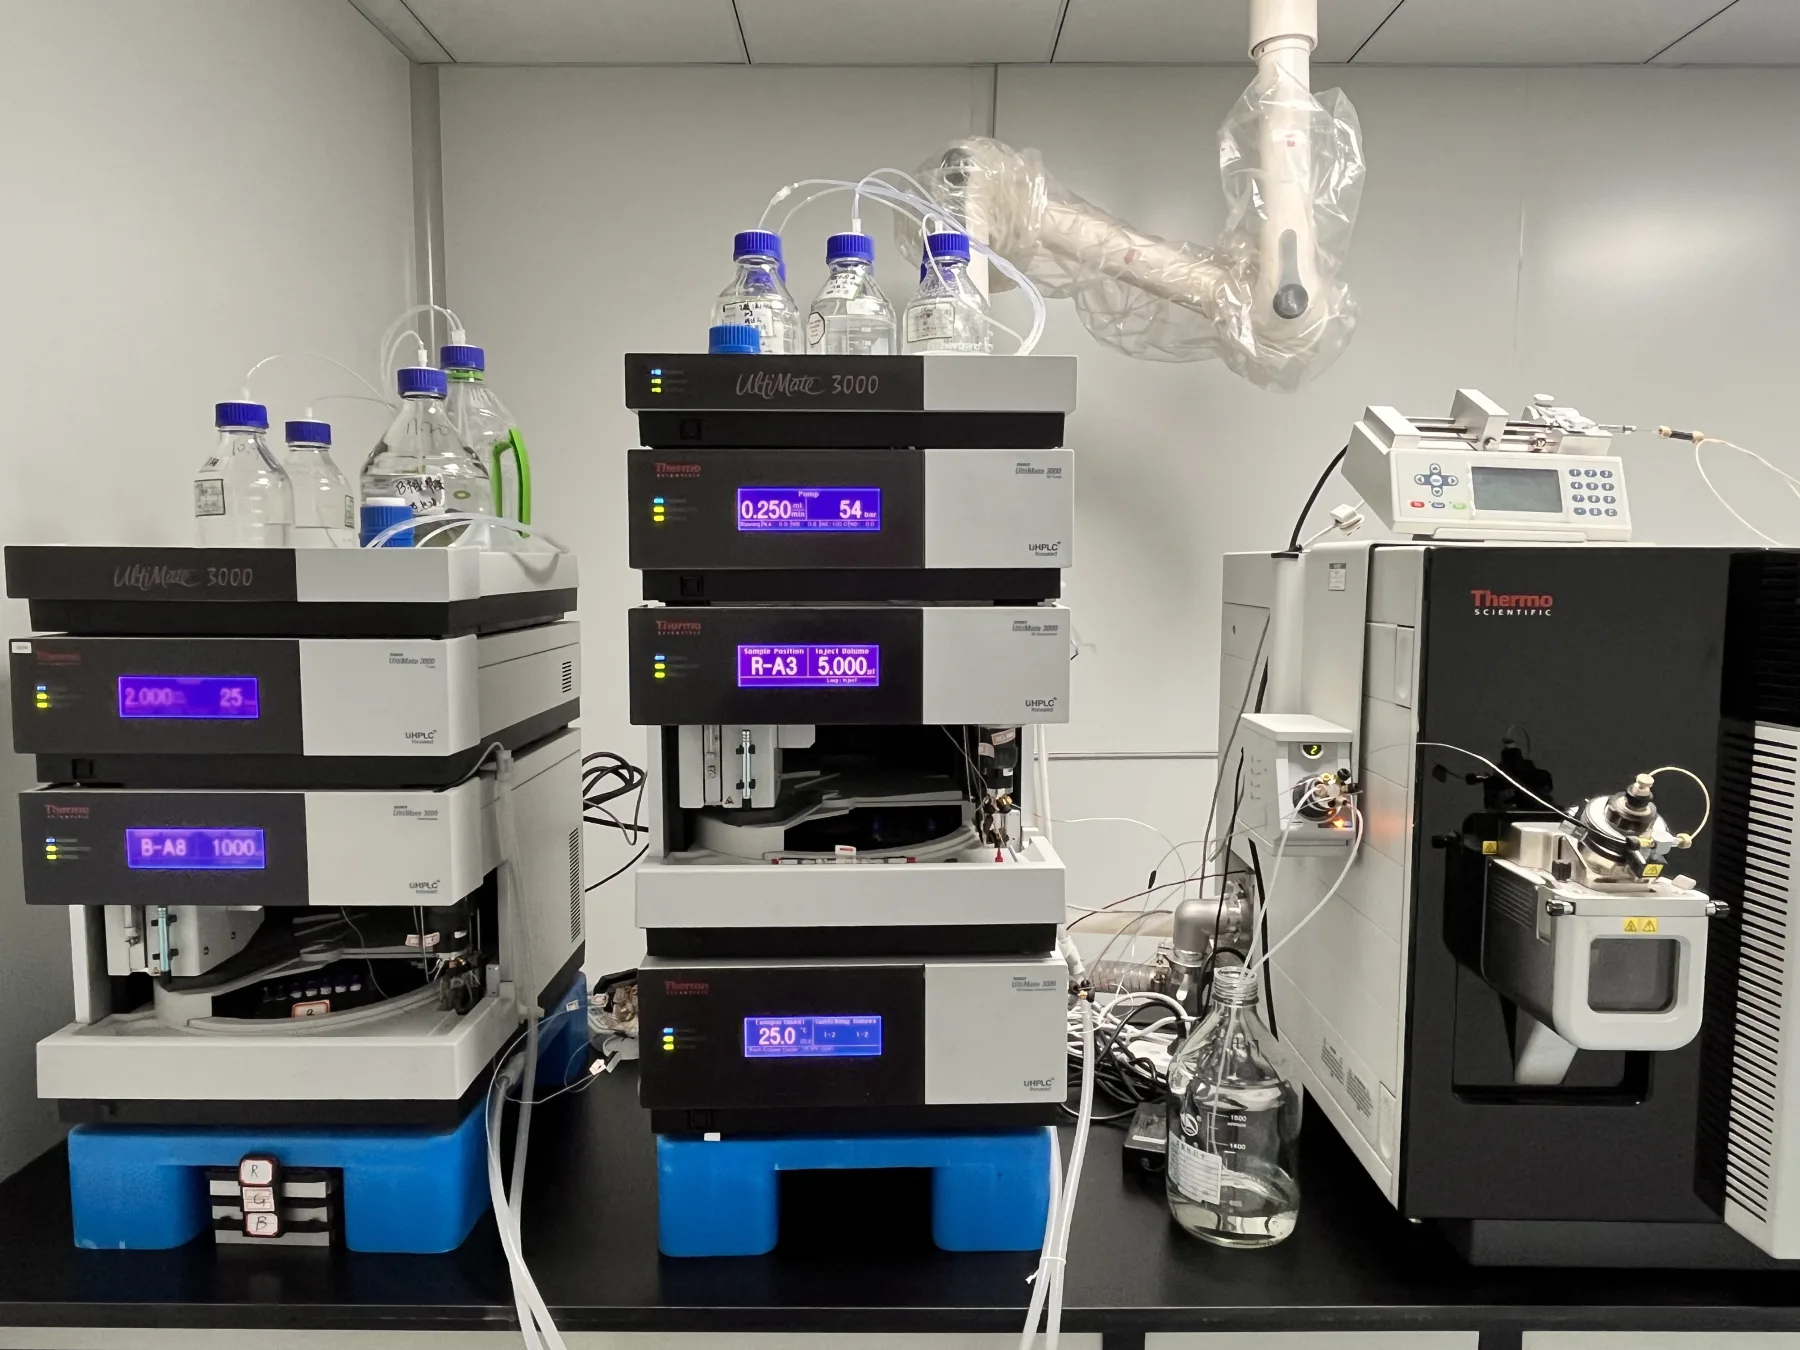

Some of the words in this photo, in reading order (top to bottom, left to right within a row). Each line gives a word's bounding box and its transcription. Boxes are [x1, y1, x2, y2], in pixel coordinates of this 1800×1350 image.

[735, 371, 827, 399] UltiMate
[831, 374, 879, 394] 3000
[798, 490, 819, 498] Pump
[741, 500, 791, 519] 0.250
[791, 510, 805, 518] min
[839, 500, 862, 519] 54
[113, 563, 200, 591] UltiMate
[207, 567, 253, 587] 3000
[1470, 590, 1553, 607] Thermo
[751, 656, 798, 675] R-A3
[818, 656, 868, 675] 5.000
[220, 687, 243, 706] 25
[1311, 745, 1318, 755] 2
[141, 838, 187, 856] B-A8
[759, 1027, 796, 1045] 25.0
[250, 1164, 258, 1179] R
[255, 1215, 268, 1232] B
